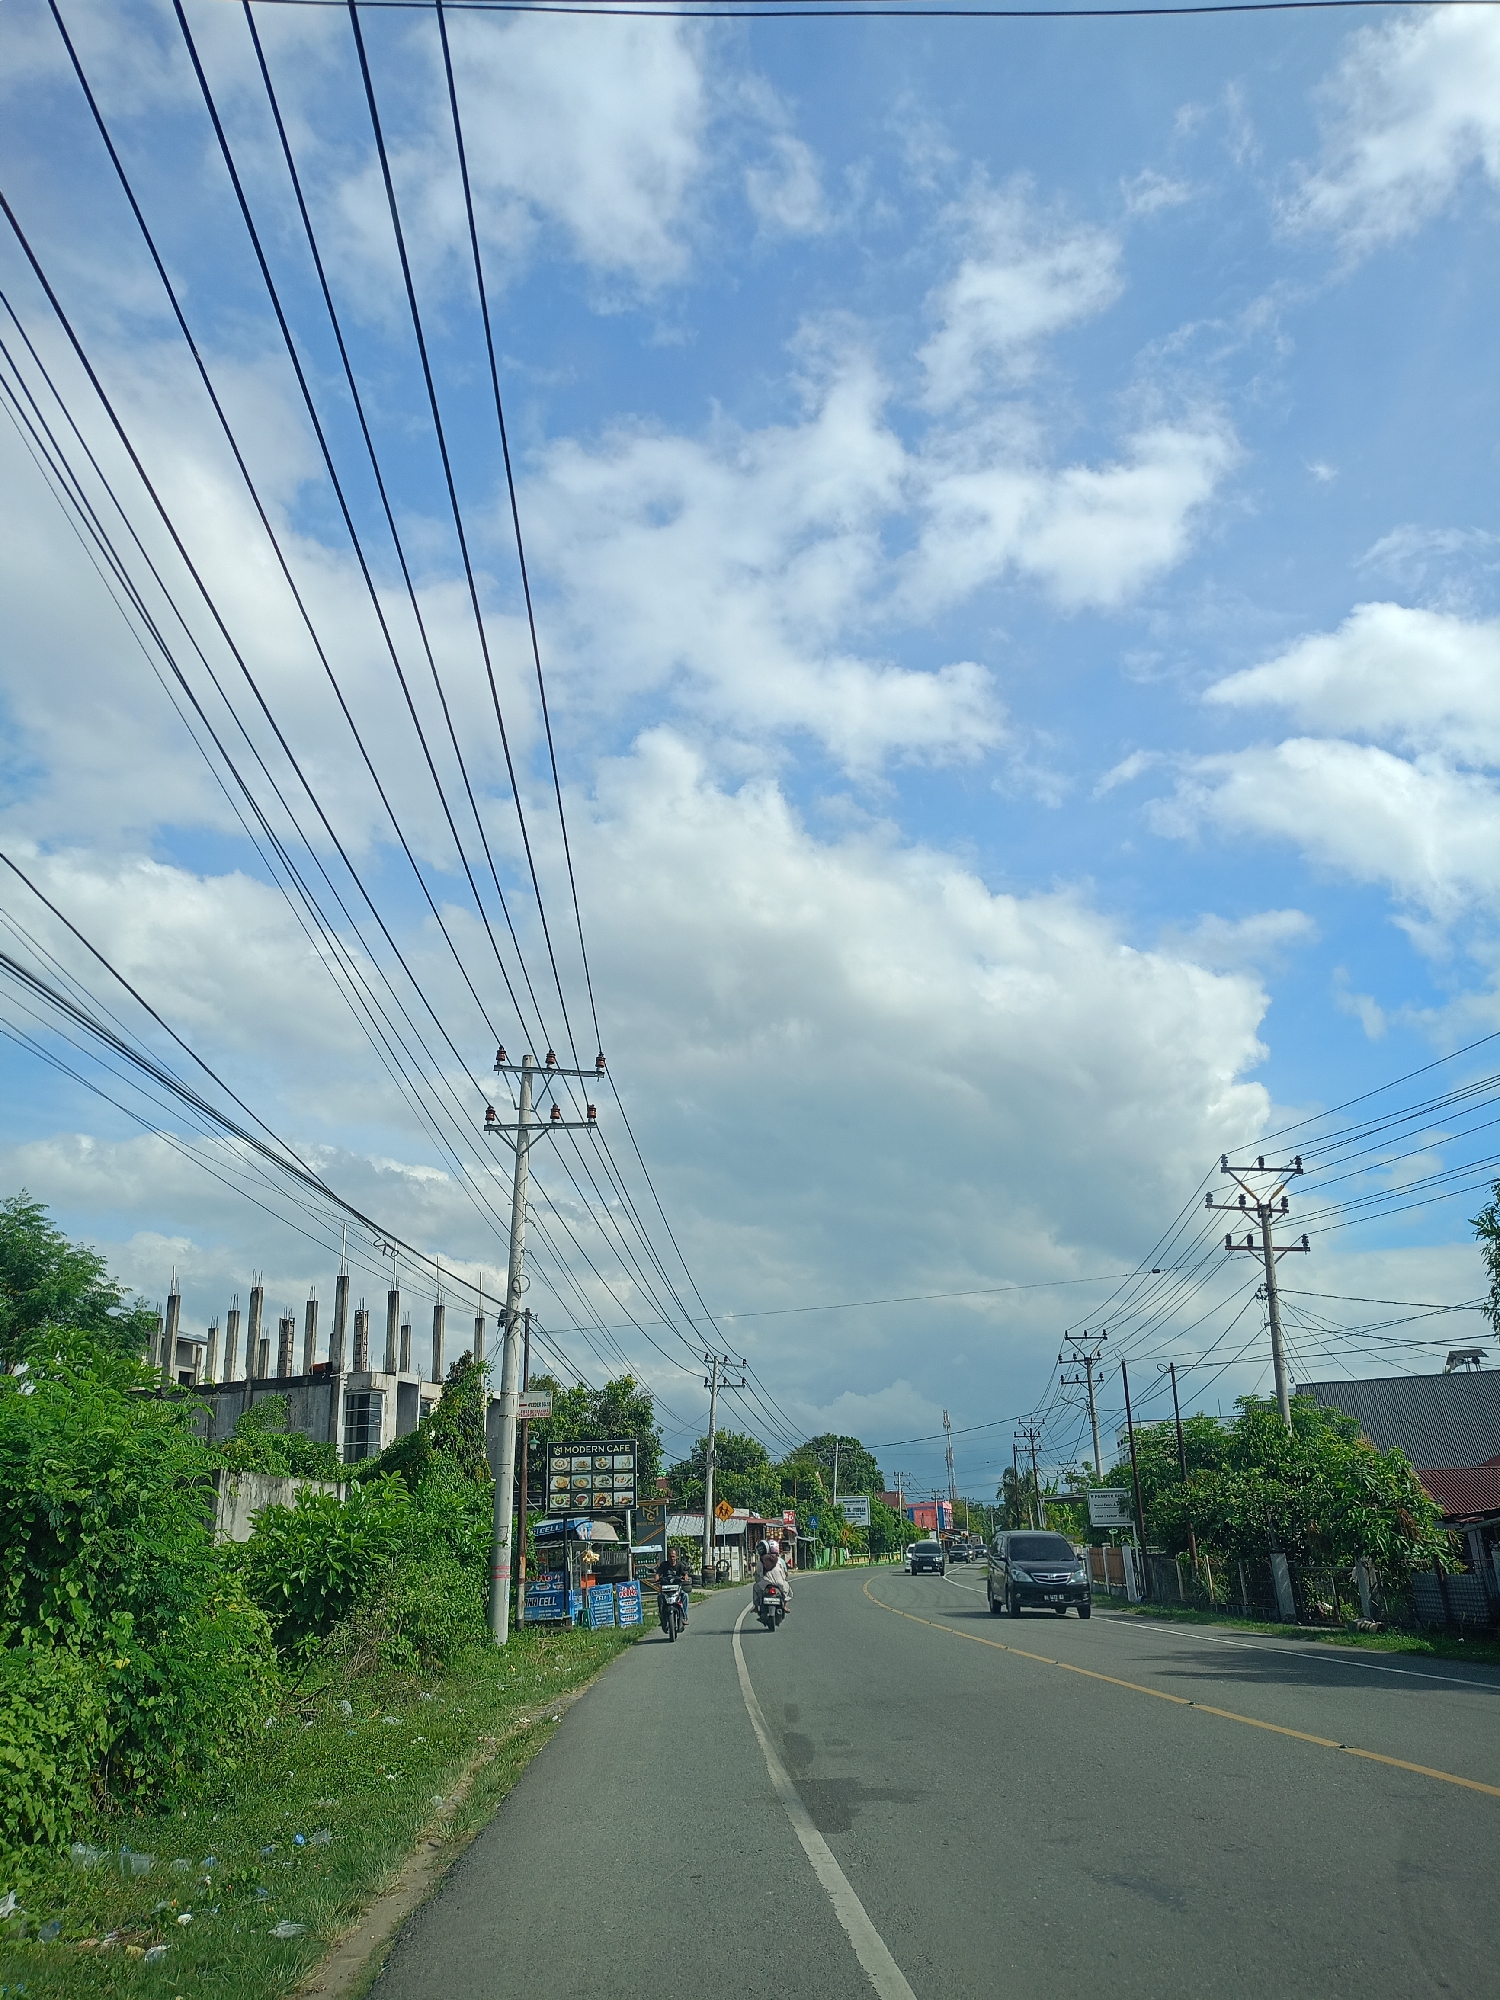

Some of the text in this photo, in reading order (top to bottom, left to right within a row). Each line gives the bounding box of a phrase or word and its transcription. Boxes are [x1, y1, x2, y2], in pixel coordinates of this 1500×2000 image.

[564, 1444, 631, 1454] MODERN CAFE
[540, 1525, 561, 1534] CELL
[539, 1596, 557, 1607] CELL
